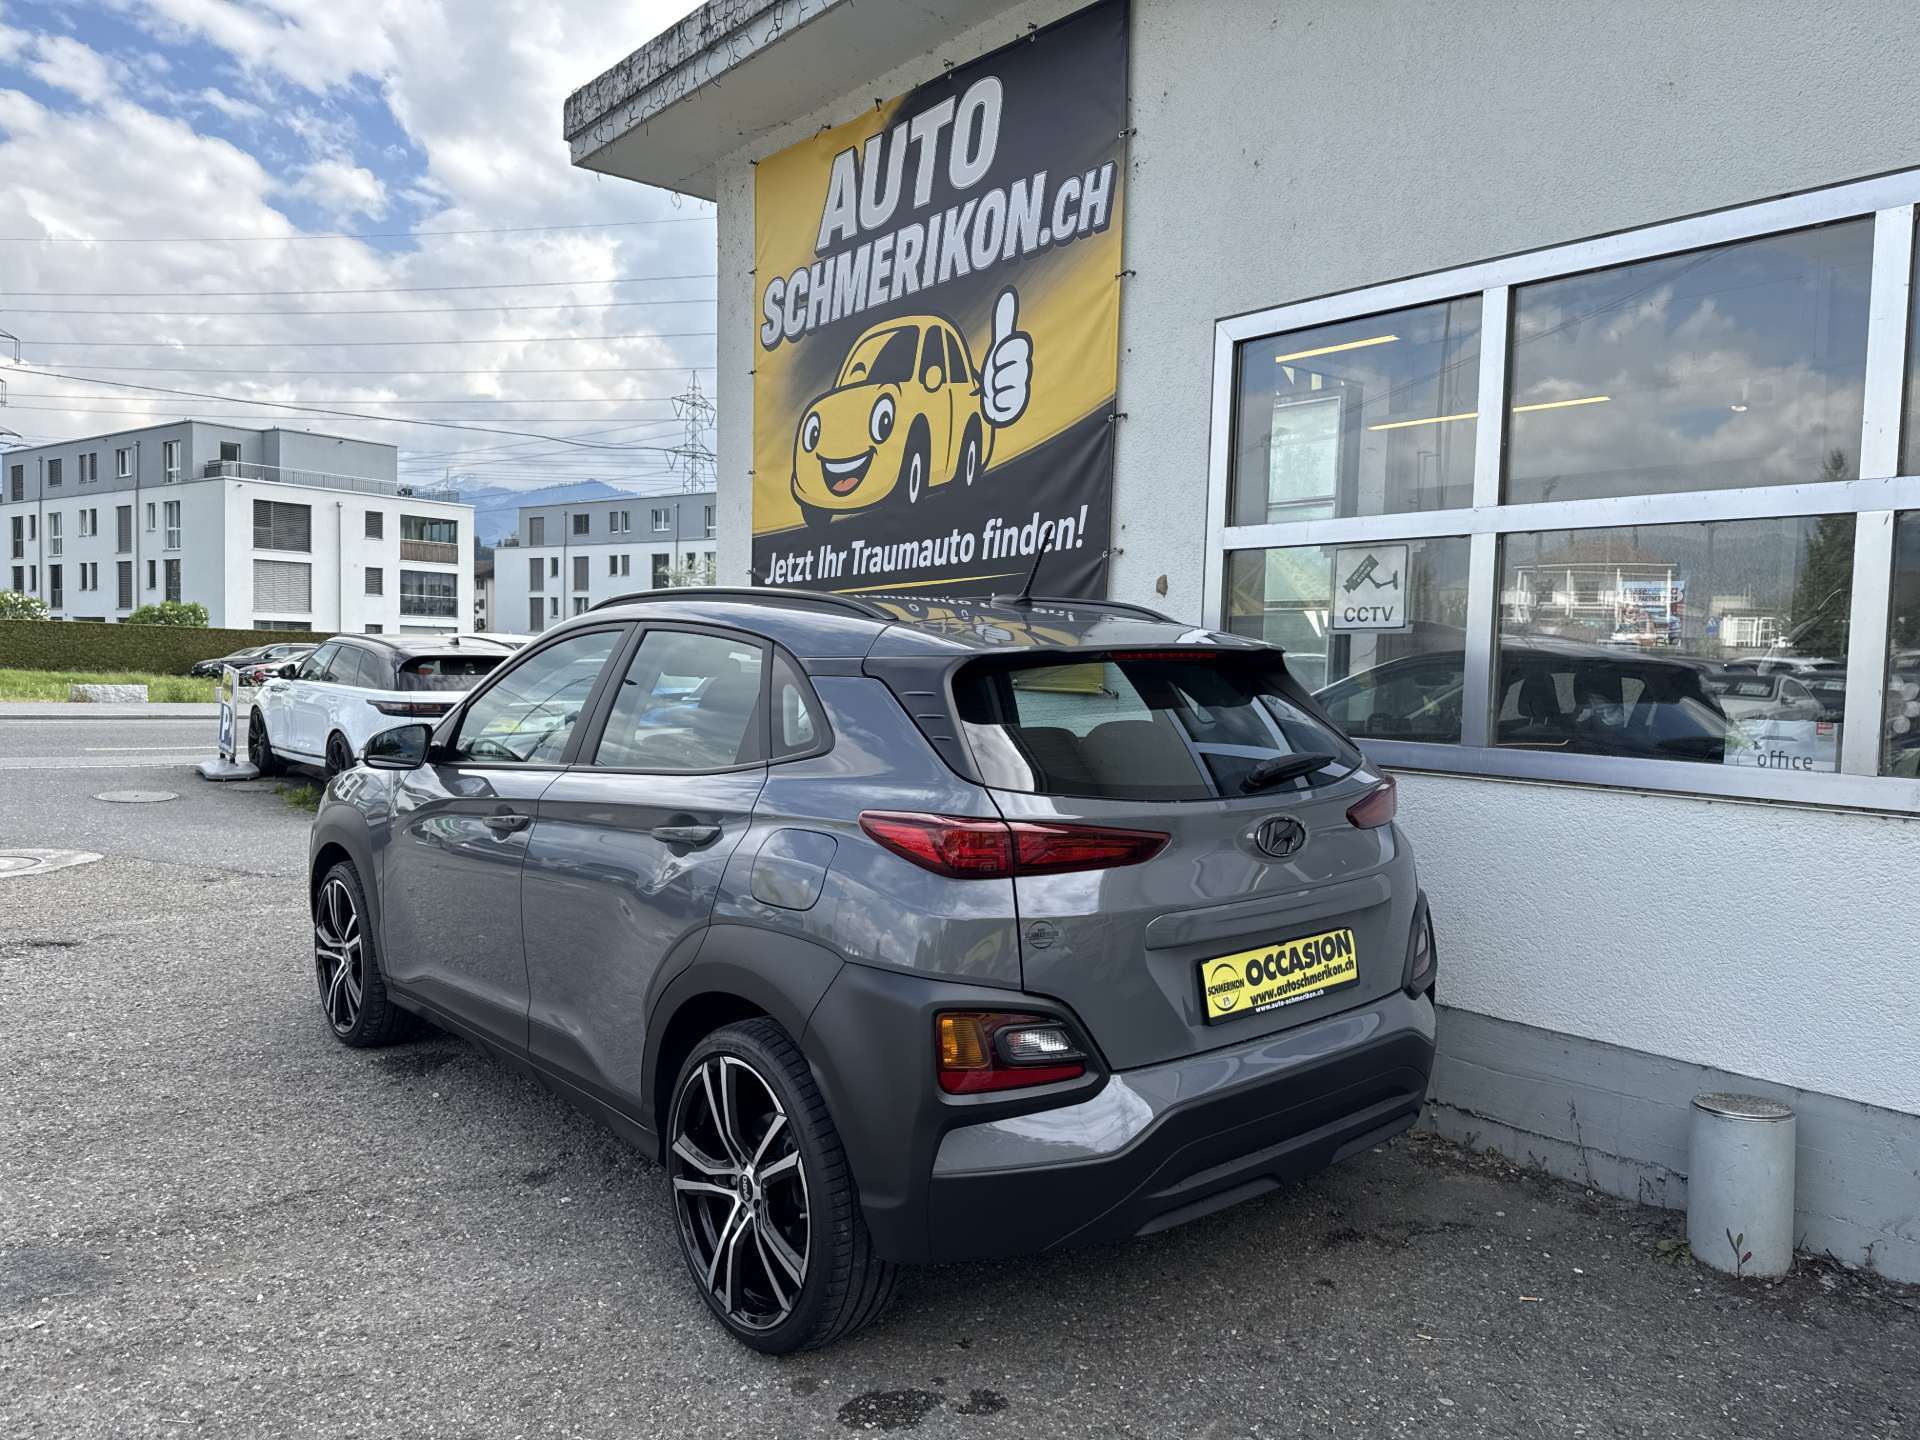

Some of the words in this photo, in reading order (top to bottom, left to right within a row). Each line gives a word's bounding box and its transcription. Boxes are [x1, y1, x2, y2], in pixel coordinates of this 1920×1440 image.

[815, 75, 1004, 252] AUTO
[760, 162, 1116, 348] SCHMERIKON.CH
[764, 551, 814, 586] Jetzt
[817, 544, 848, 579] Ihr
[851, 528, 974, 575] Traumauto
[982, 504, 1089, 560] finden!
[1344, 606, 1394, 622] CCTV
[221, 704, 230, 742] P
[1757, 750, 1814, 771] office
[1245, 929, 1352, 987] OCCASION
[1249, 956, 1355, 1007] www.autoschmerikon.ch
[1207, 978, 1245, 996] SCHMERIKON
